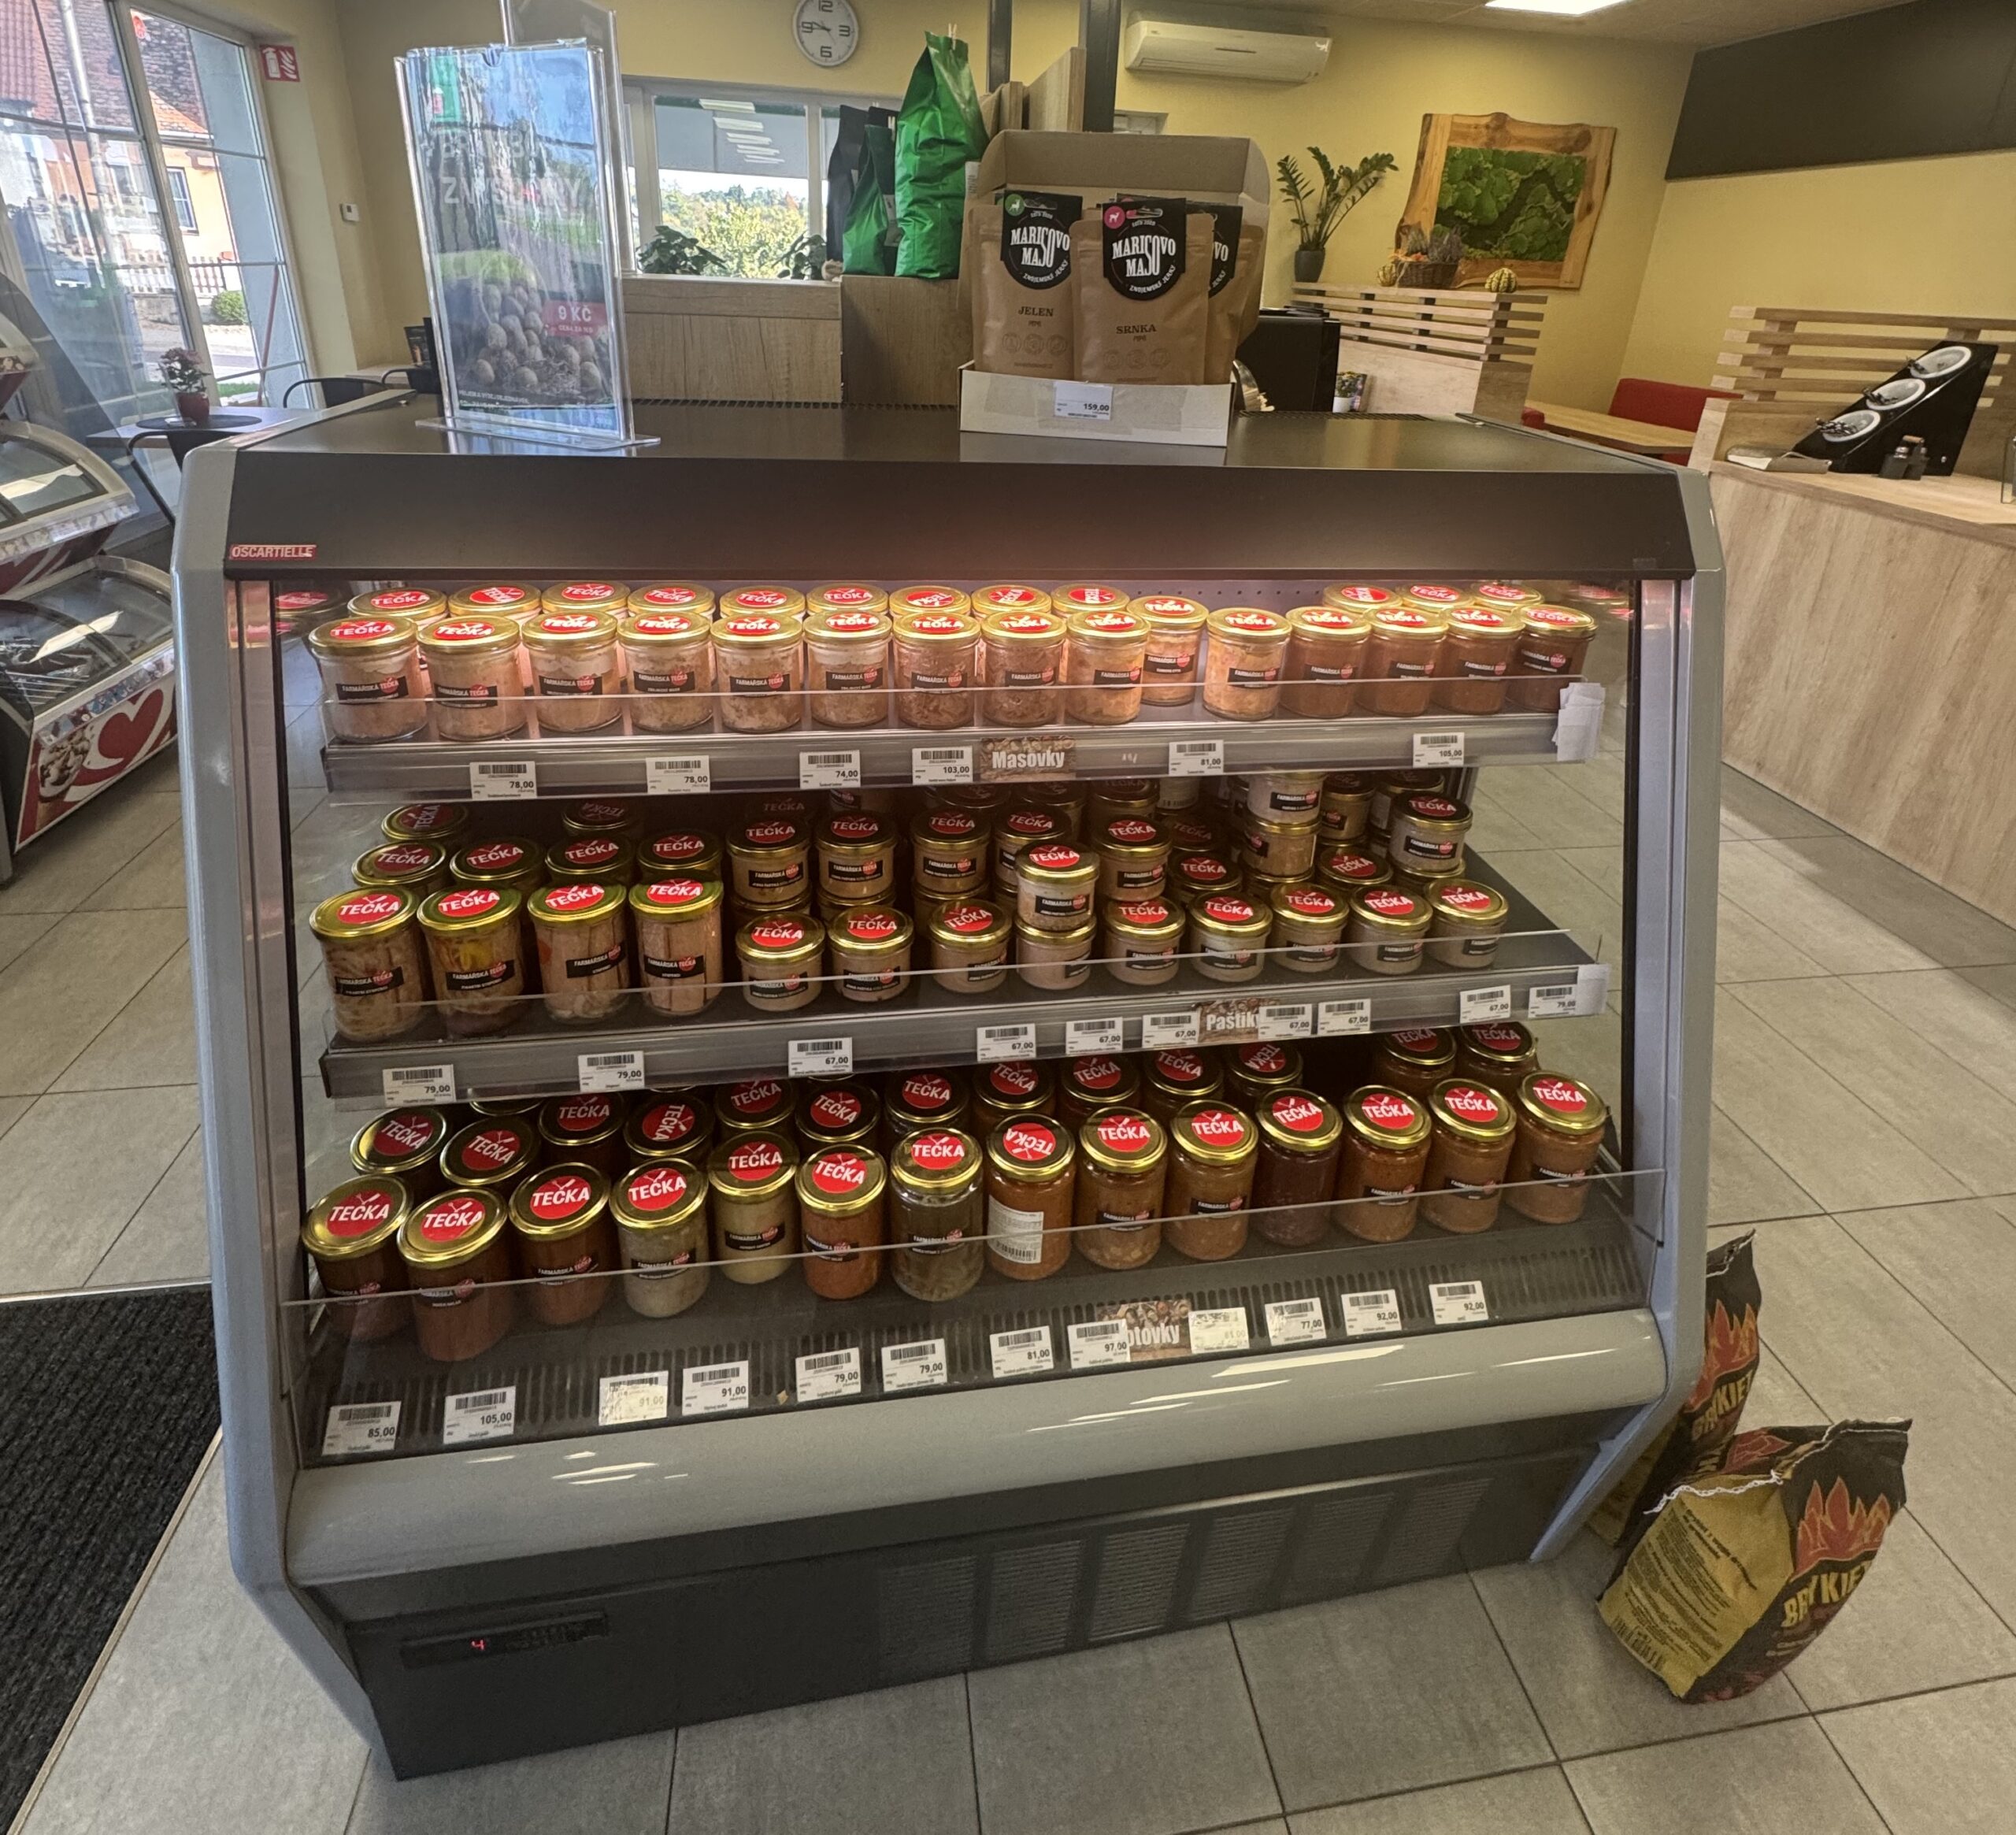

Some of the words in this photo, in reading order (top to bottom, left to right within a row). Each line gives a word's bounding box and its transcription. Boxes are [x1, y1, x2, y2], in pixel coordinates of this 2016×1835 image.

[819, 0, 833, 13] 12
[802, 21, 813, 33] 9
[839, 24, 850, 36] 3
[821, 46, 832, 57] 6
[1112, 235, 1176, 259] MARISOVO
[1162, 265, 1176, 284] JERKY
[558, 307, 566, 320] 9
[571, 306, 591, 321] KČ
[1018, 306, 1053, 317] JELEN
[1116, 324, 1156, 334] SRNKA
[1439, 749, 1462, 759] 105,00
[991, 751, 1065, 769] Masovky
[1200, 758, 1221, 767] 81,00
[836, 770, 858, 779] 74,00
[943, 766, 969, 775] 103,00
[509, 780, 534, 790] 78,00
[684, 775, 708, 784] 78,00
[1489, 1003, 1509, 1012] 67,00
[1099, 1035, 1121, 1044] 67,00
[1175, 1029, 1196, 1039] 67,00
[1012, 1041, 1034, 1051] 67,00
[825, 1056, 849, 1066] 67,00
[617, 1069, 642, 1080] 79,00
[424, 1084, 450, 1095] 79,00
[1463, 1302, 1484, 1311] 92,00
[1377, 1311, 1398, 1321] 92,00
[1301, 1319, 1322, 1329] 77,00
[1104, 1342, 1127, 1352] 97,00
[1027, 1348, 1051, 1361] 81,00
[919, 1362, 943, 1375] 79,00
[834, 1371, 859, 1385] 79,00
[721, 1385, 747, 1398] 91,00
[480, 1412, 512, 1425] 105,00
[368, 1426, 395, 1439] 85,00
[471, 1639, 485, 1651] 4
